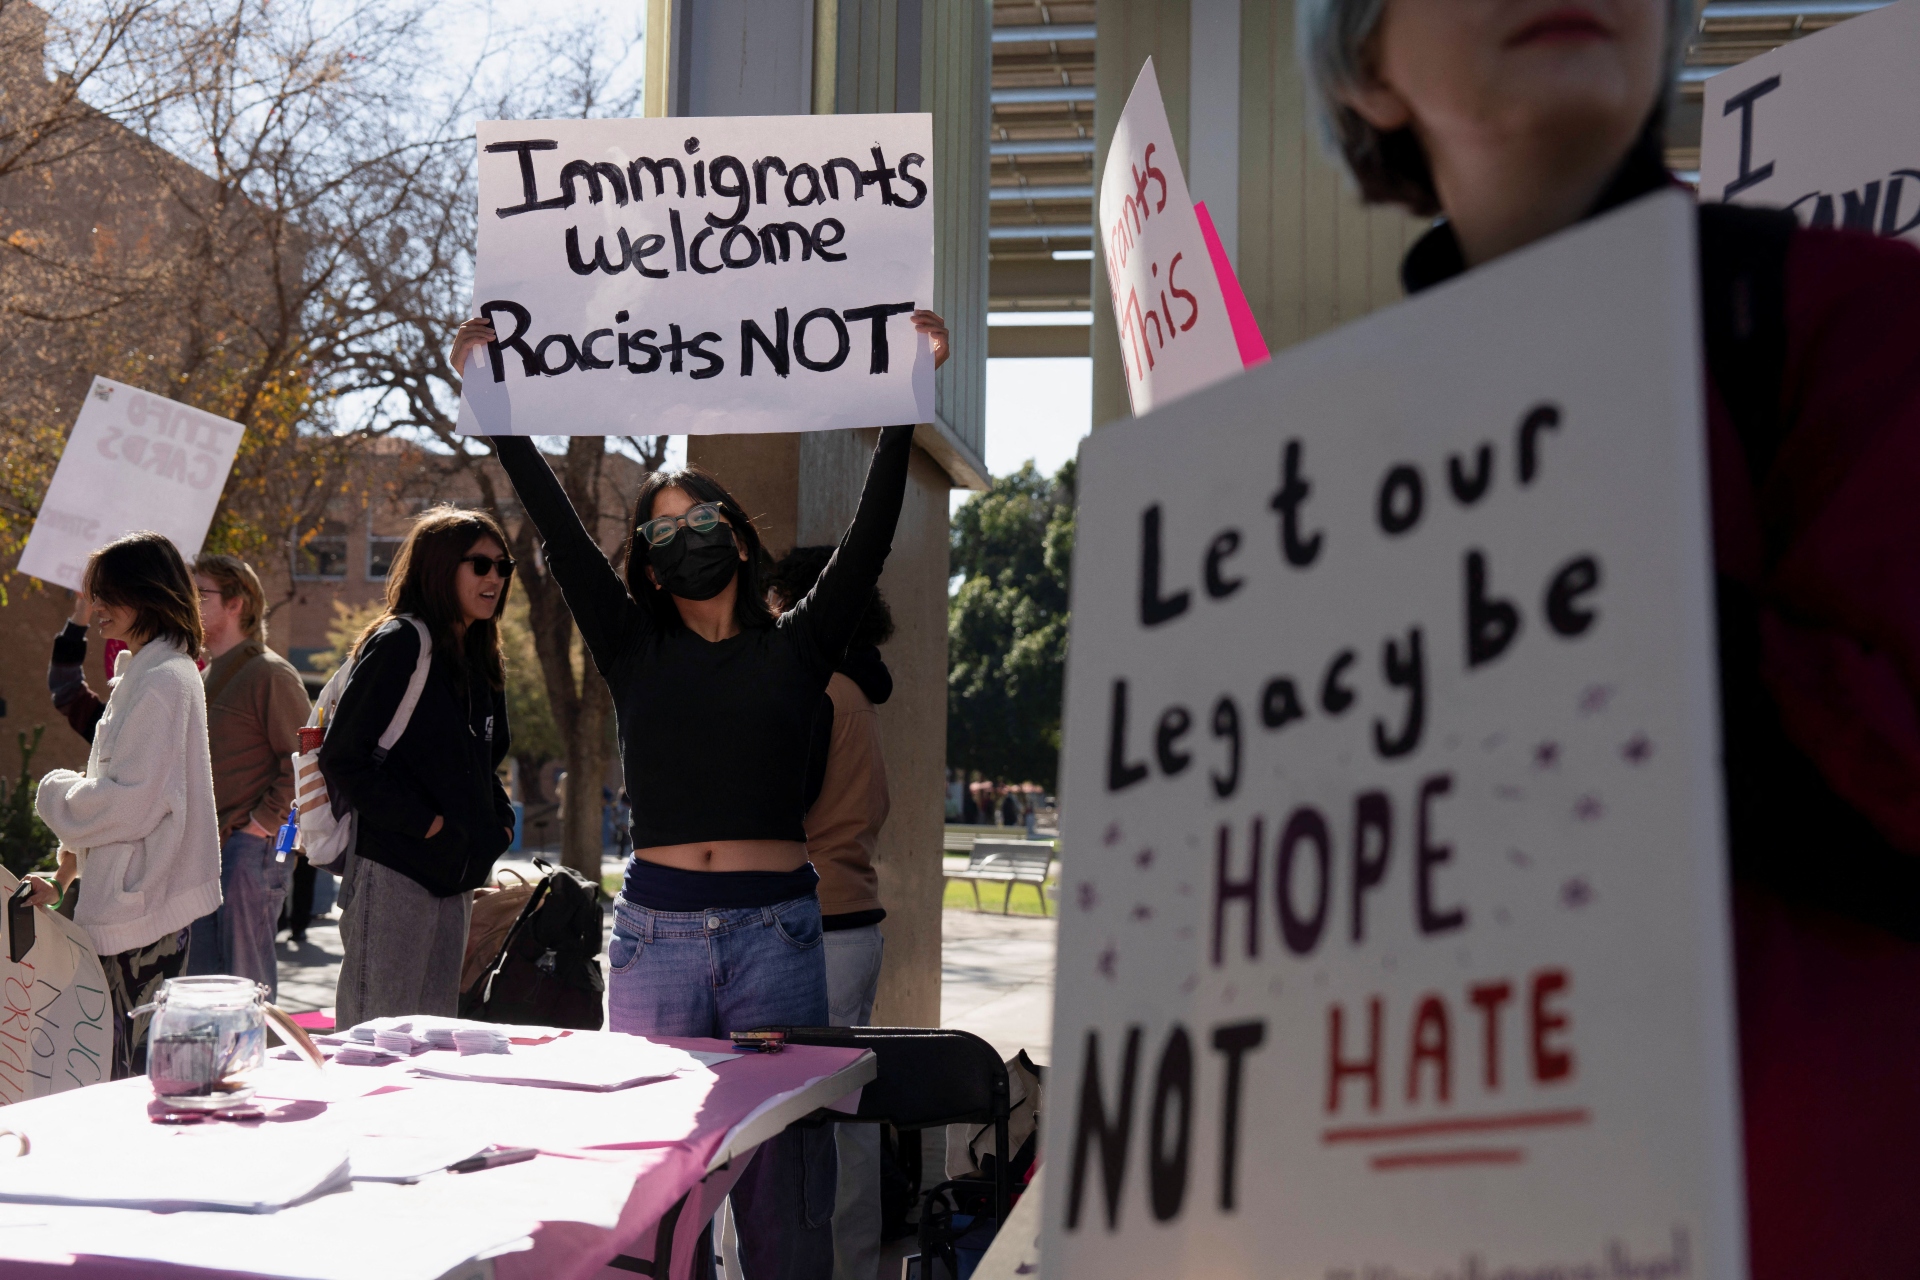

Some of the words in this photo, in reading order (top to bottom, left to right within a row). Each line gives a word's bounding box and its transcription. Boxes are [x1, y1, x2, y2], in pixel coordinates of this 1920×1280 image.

[483, 136, 928, 229] Immigrants
[1722, 73, 1782, 203] I
[565, 207, 848, 279] welcome
[480, 299, 725, 383] Racists
[740, 301, 915, 379] NOT
[1121, 251, 1199, 382] This
[1139, 437, 1325, 628] Let
[1374, 403, 1562, 537] our
[1107, 627, 1426, 799] Legacy
[1464, 549, 1603, 673] be
[1211, 775, 1466, 968] HOPE
[26, 978, 62, 1094] NOT
[1063, 1018, 1266, 1233] NOT
[1325, 967, 1577, 1116] HATE
